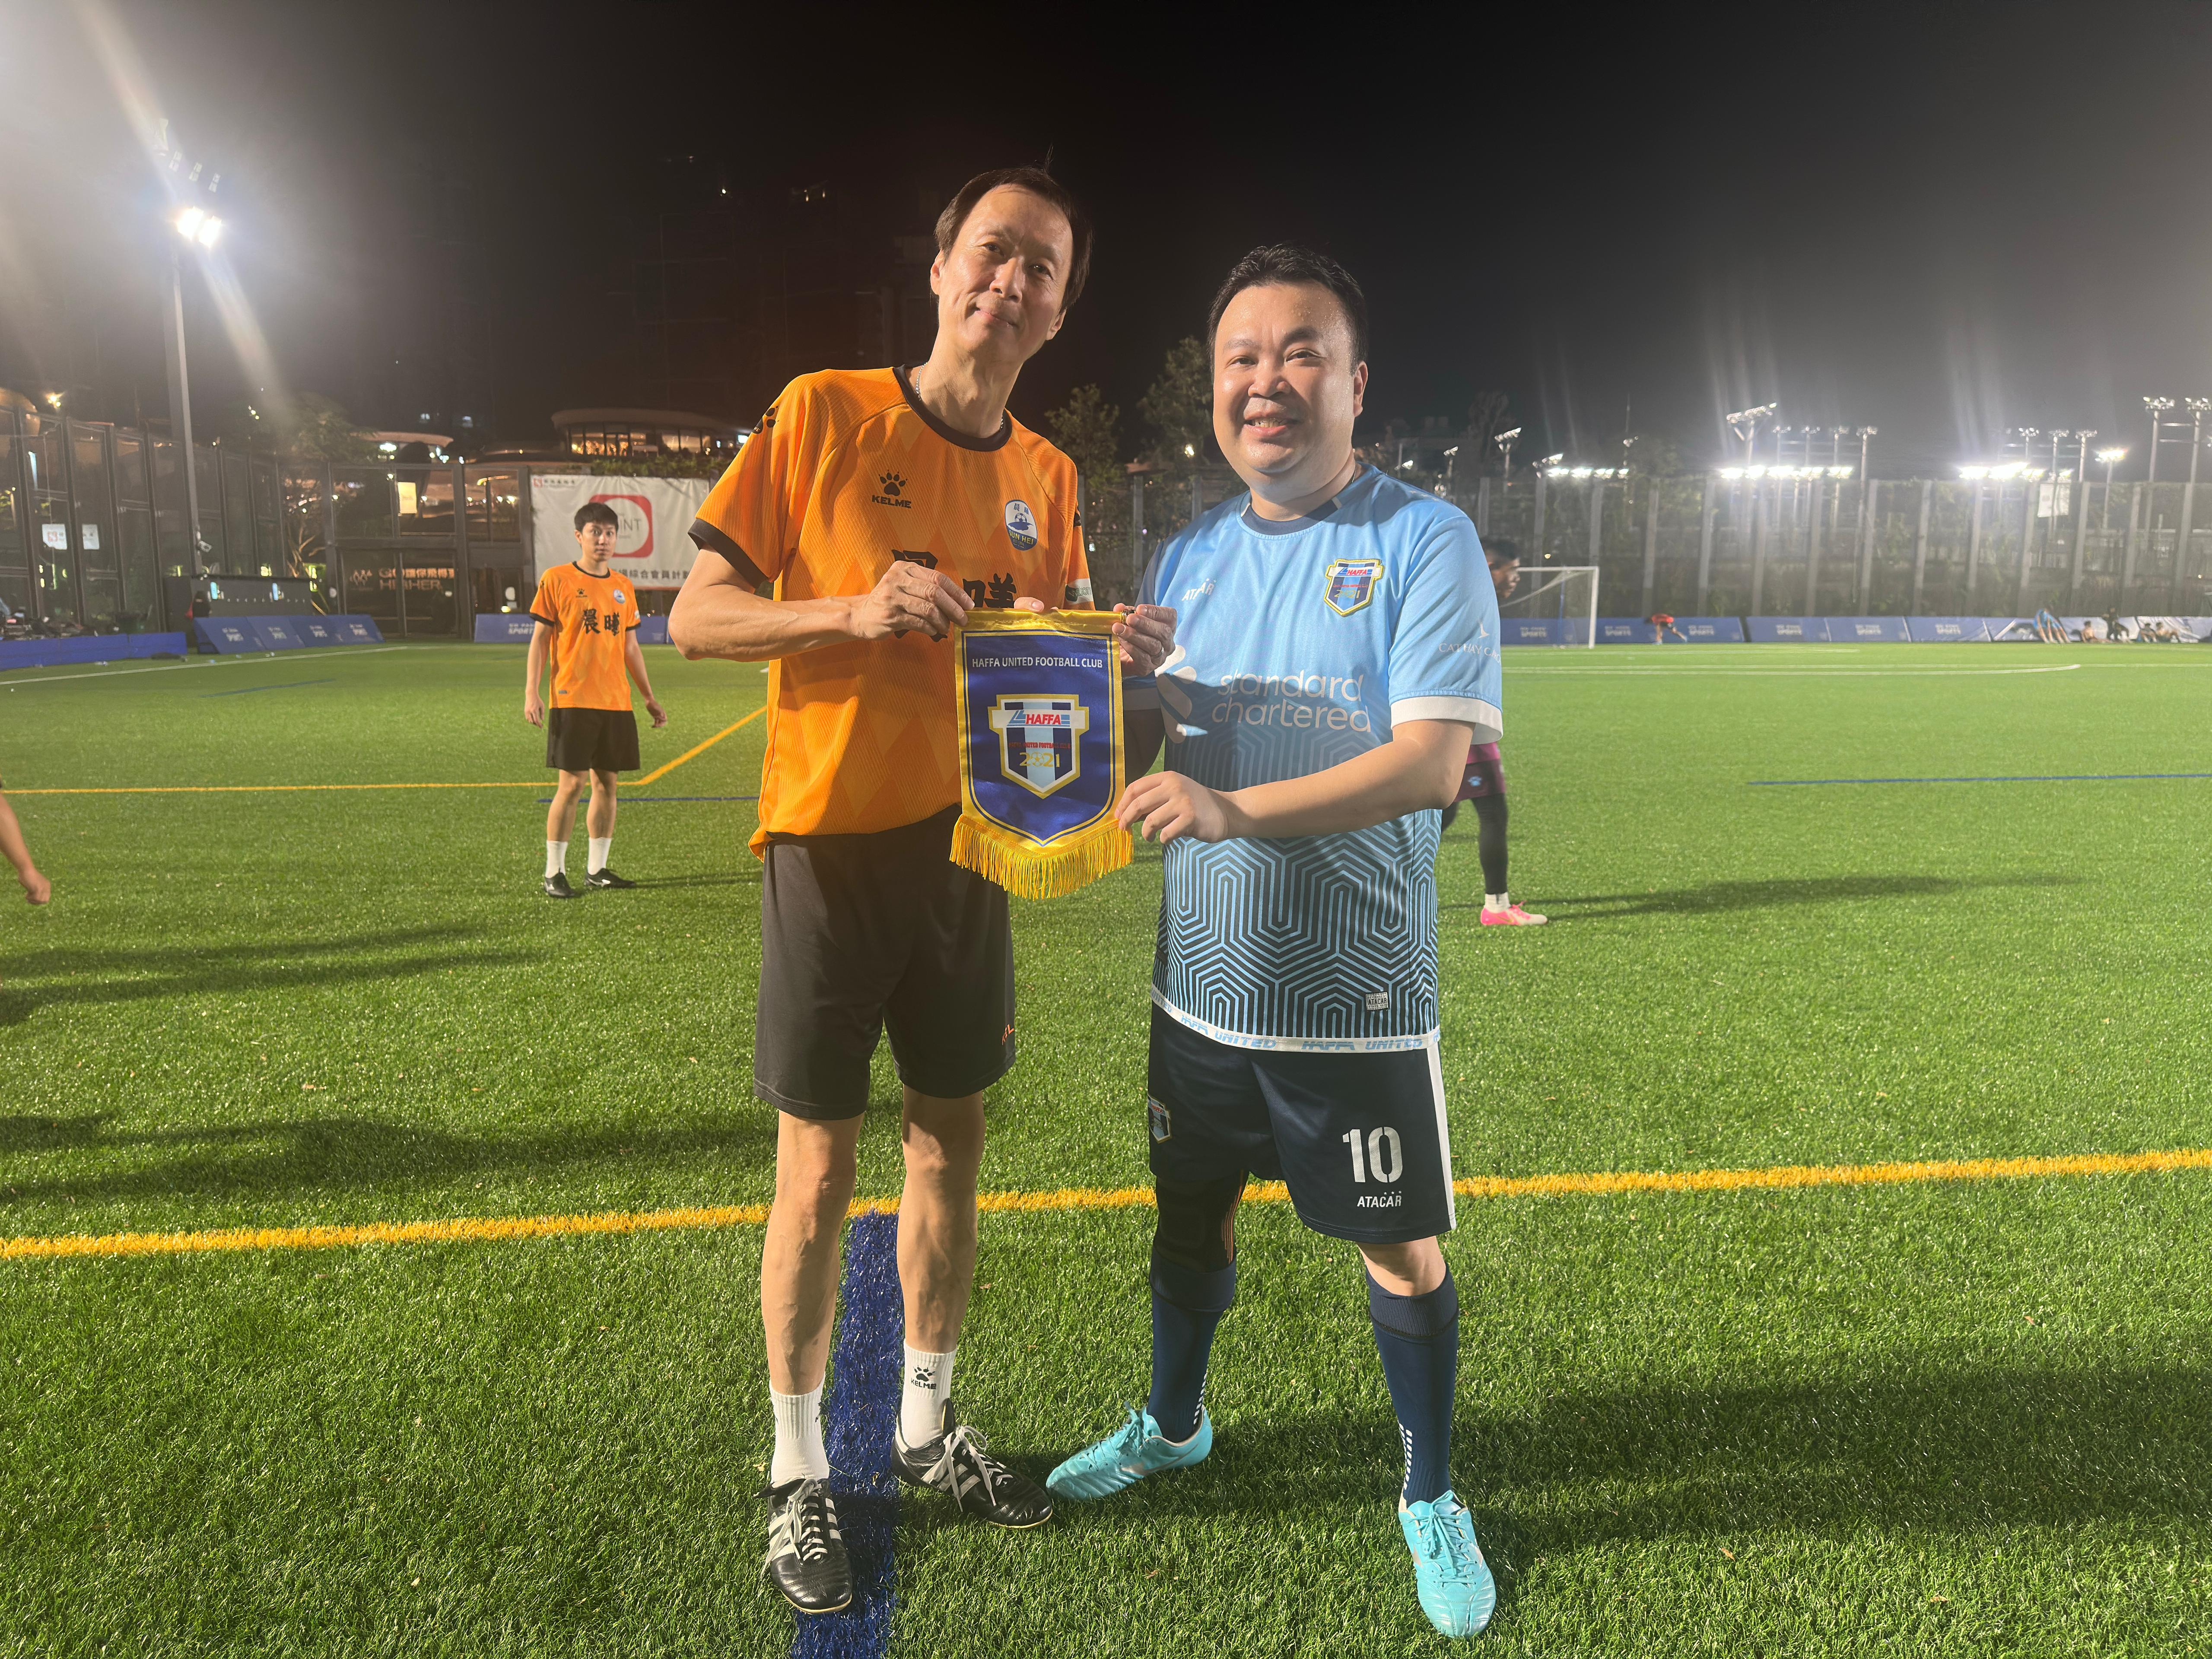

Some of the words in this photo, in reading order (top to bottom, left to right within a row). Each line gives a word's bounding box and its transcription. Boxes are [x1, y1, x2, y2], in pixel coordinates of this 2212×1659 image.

[872, 495, 911, 509] KELME
[620, 518, 642, 532] INT
[1009, 530, 1020, 540] SUN
[1022, 535, 1034, 545] HEI
[972, 658, 1000, 667] HAFFA
[1002, 657, 1033, 667] UNITED
[1036, 657, 1080, 667] FOOTBALL
[1081, 658, 1103, 668] CLUB
[1217, 669, 1364, 702] standard
[1025, 714, 1061, 725] HAFFA
[1211, 697, 1371, 733] chartered
[1368, 997, 1387, 1005] ATACAR
[1214, 1030, 1276, 1049] UNITED
[1365, 1038, 1423, 1050] UNITED
[1342, 1126, 1403, 1183] 10
[1357, 1195, 1402, 1208] ATACAR
[911, 1378, 937, 1389] KELME
